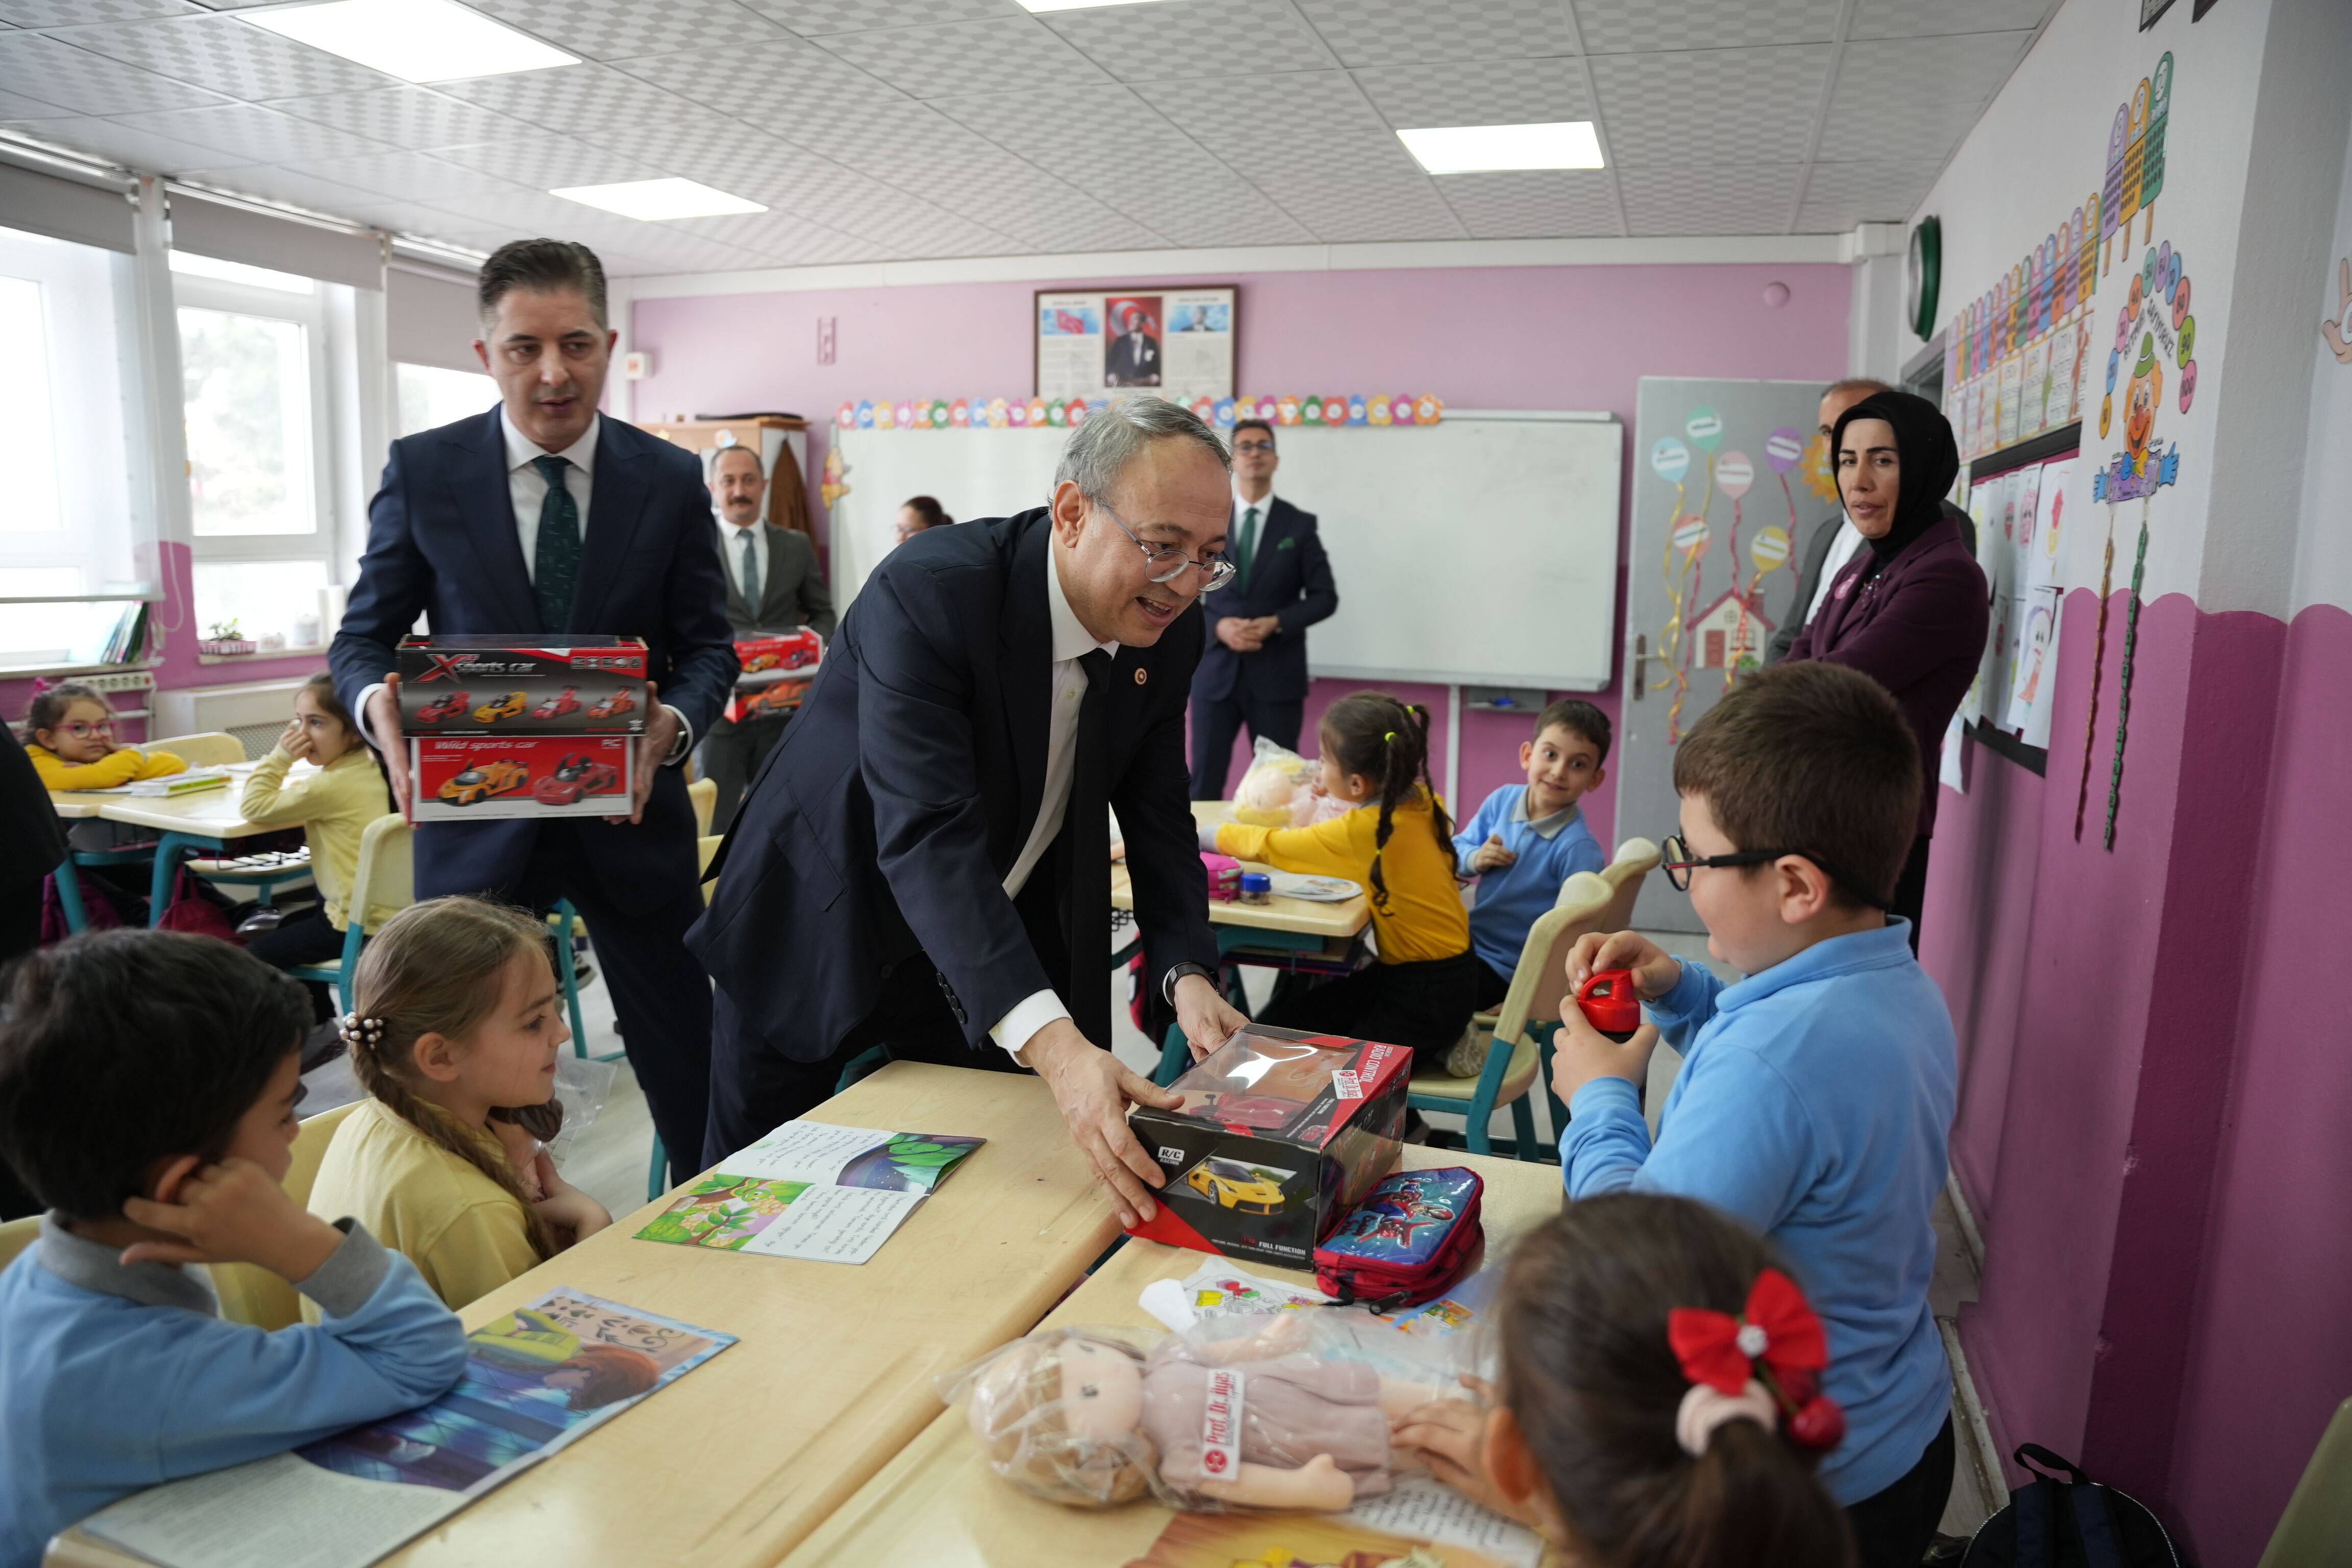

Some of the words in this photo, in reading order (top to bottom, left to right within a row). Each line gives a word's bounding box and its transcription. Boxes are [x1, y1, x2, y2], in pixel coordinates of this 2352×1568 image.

[435, 741, 469, 749] Wild
[469, 741, 514, 752] sports
[1369, 1044, 1387, 1061] RADIO
[1359, 1059, 1381, 1083] CONTROL
[1162, 1148, 1181, 1160] R/C
[1275, 1244, 1306, 1255] FUNCTION
[1206, 1417, 1228, 1445] Prof.
